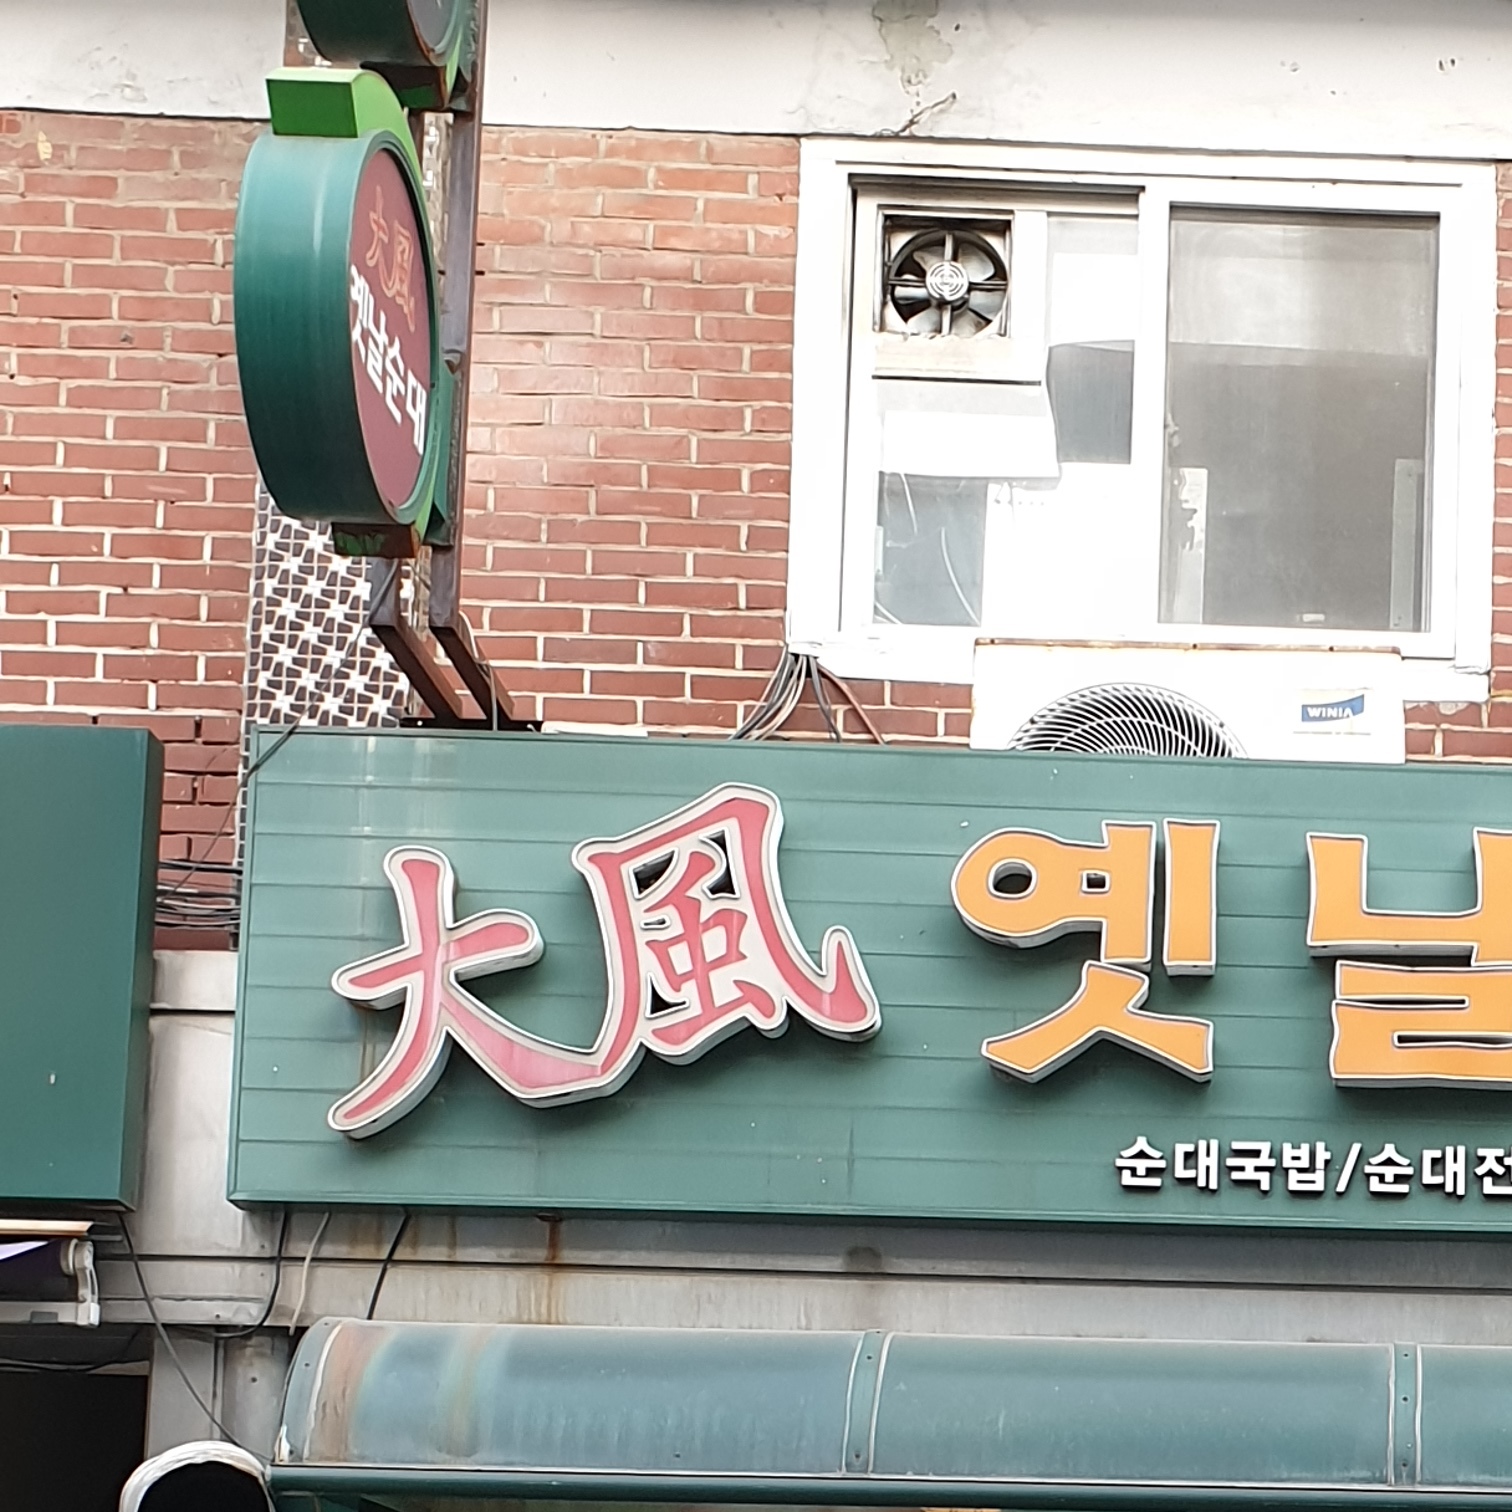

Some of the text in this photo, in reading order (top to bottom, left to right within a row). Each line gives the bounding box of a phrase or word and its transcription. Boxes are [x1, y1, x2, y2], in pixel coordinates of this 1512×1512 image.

[350, 263, 427, 456] 옛날순대
[1306, 705, 1355, 720] WINIA
[327, 782, 883, 1140] 大風
